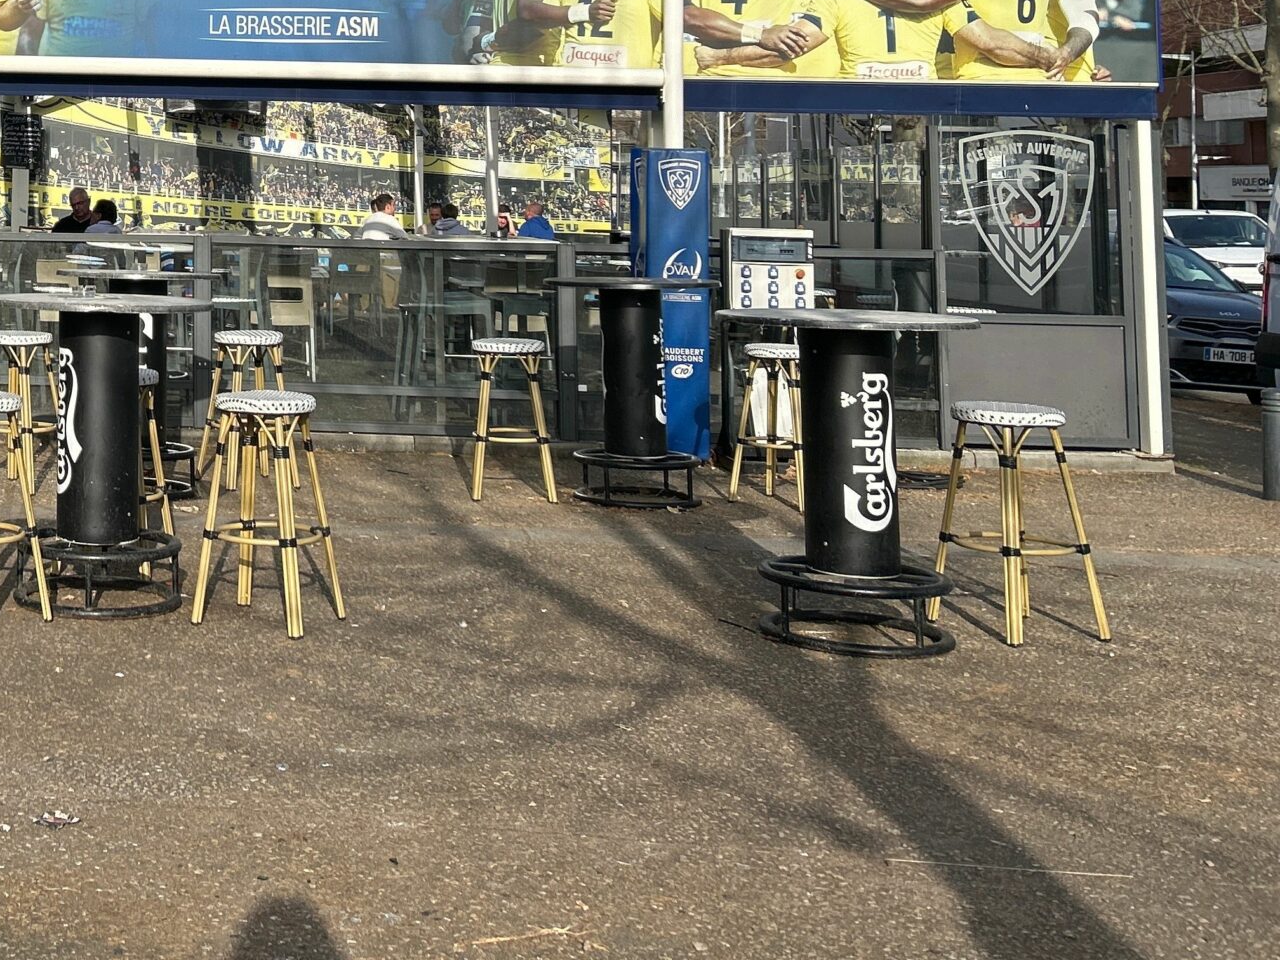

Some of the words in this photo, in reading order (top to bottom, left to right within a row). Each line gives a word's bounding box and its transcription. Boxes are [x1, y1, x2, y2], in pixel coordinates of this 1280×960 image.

[209, 14, 231, 35] LA
[236, 15, 332, 37] BRASSERIE
[336, 17, 379, 38] ASM
[566, 46, 622, 65] Jacquet
[144, 115, 285, 154] YELLOW
[300, 142, 385, 166] ARMY
[966, 143, 1023, 164] CLERMONT
[1026, 142, 1088, 164] AUVERGNE
[1231, 177, 1258, 187] BANQUE
[666, 265, 697, 277] OVAL
[665, 348, 705, 356] AUDEBERT
[665, 354, 704, 362] BOISSONS
[843, 372, 897, 532] Carlsberg
